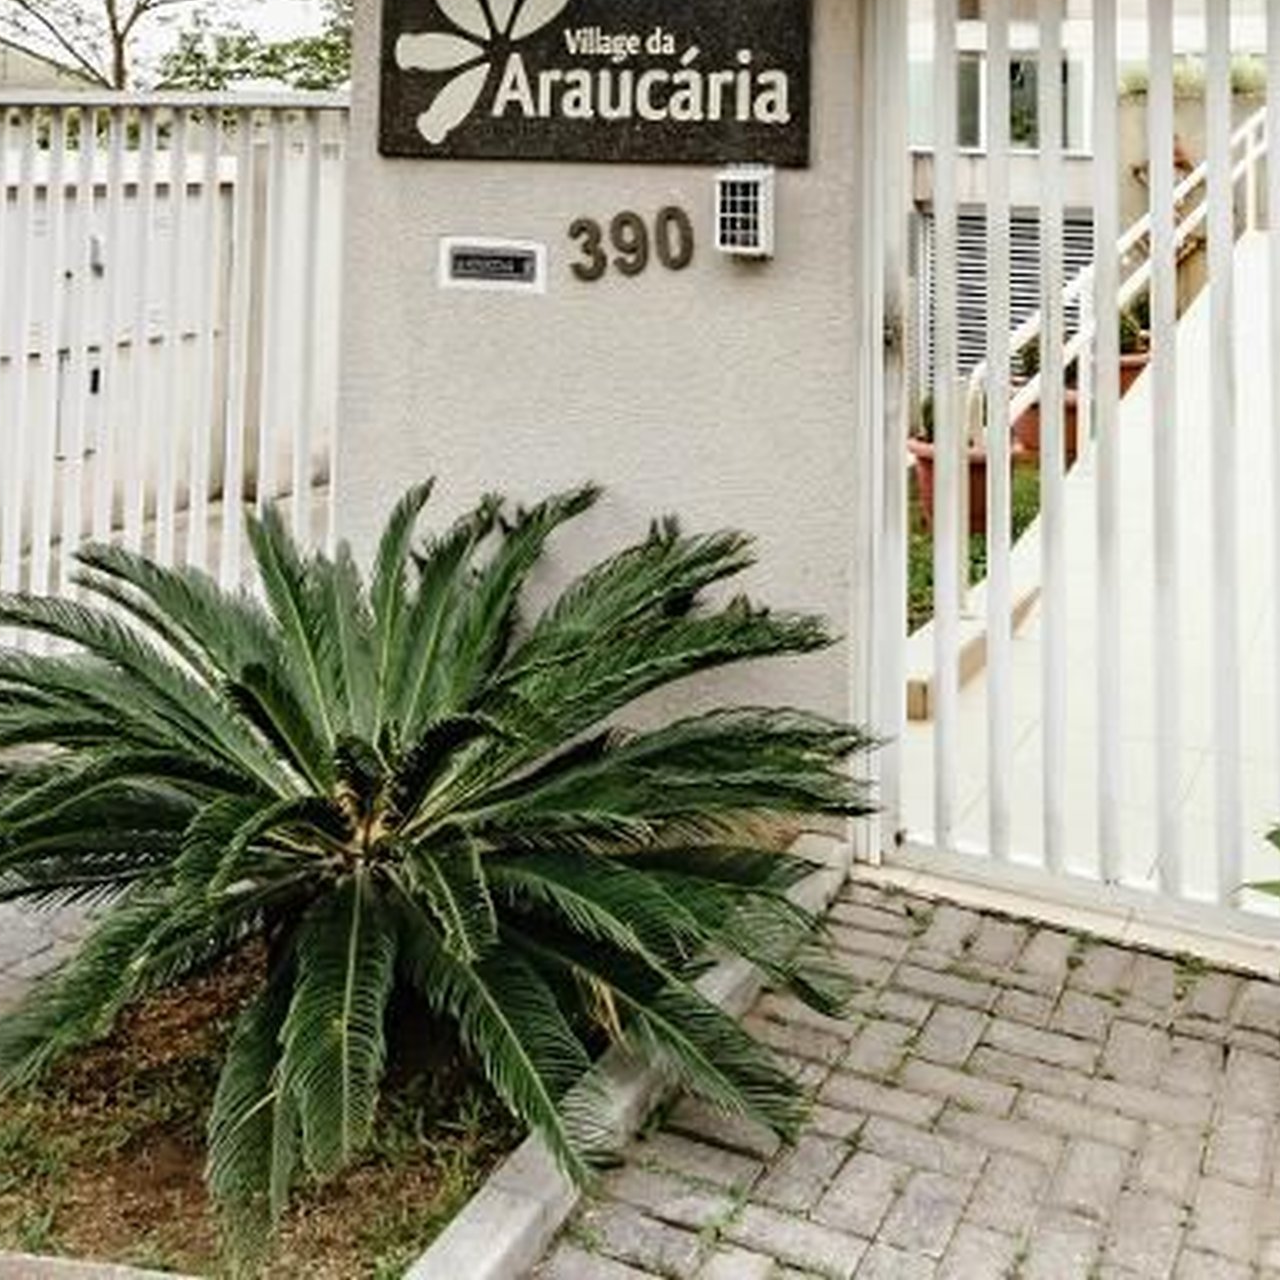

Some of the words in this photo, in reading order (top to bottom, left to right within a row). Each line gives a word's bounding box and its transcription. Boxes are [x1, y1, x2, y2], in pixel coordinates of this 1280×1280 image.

[564, 28, 640, 62] Village
[646, 27, 674, 55] da
[492, 47, 790, 123] Araucária
[569, 207, 694, 280] 390
